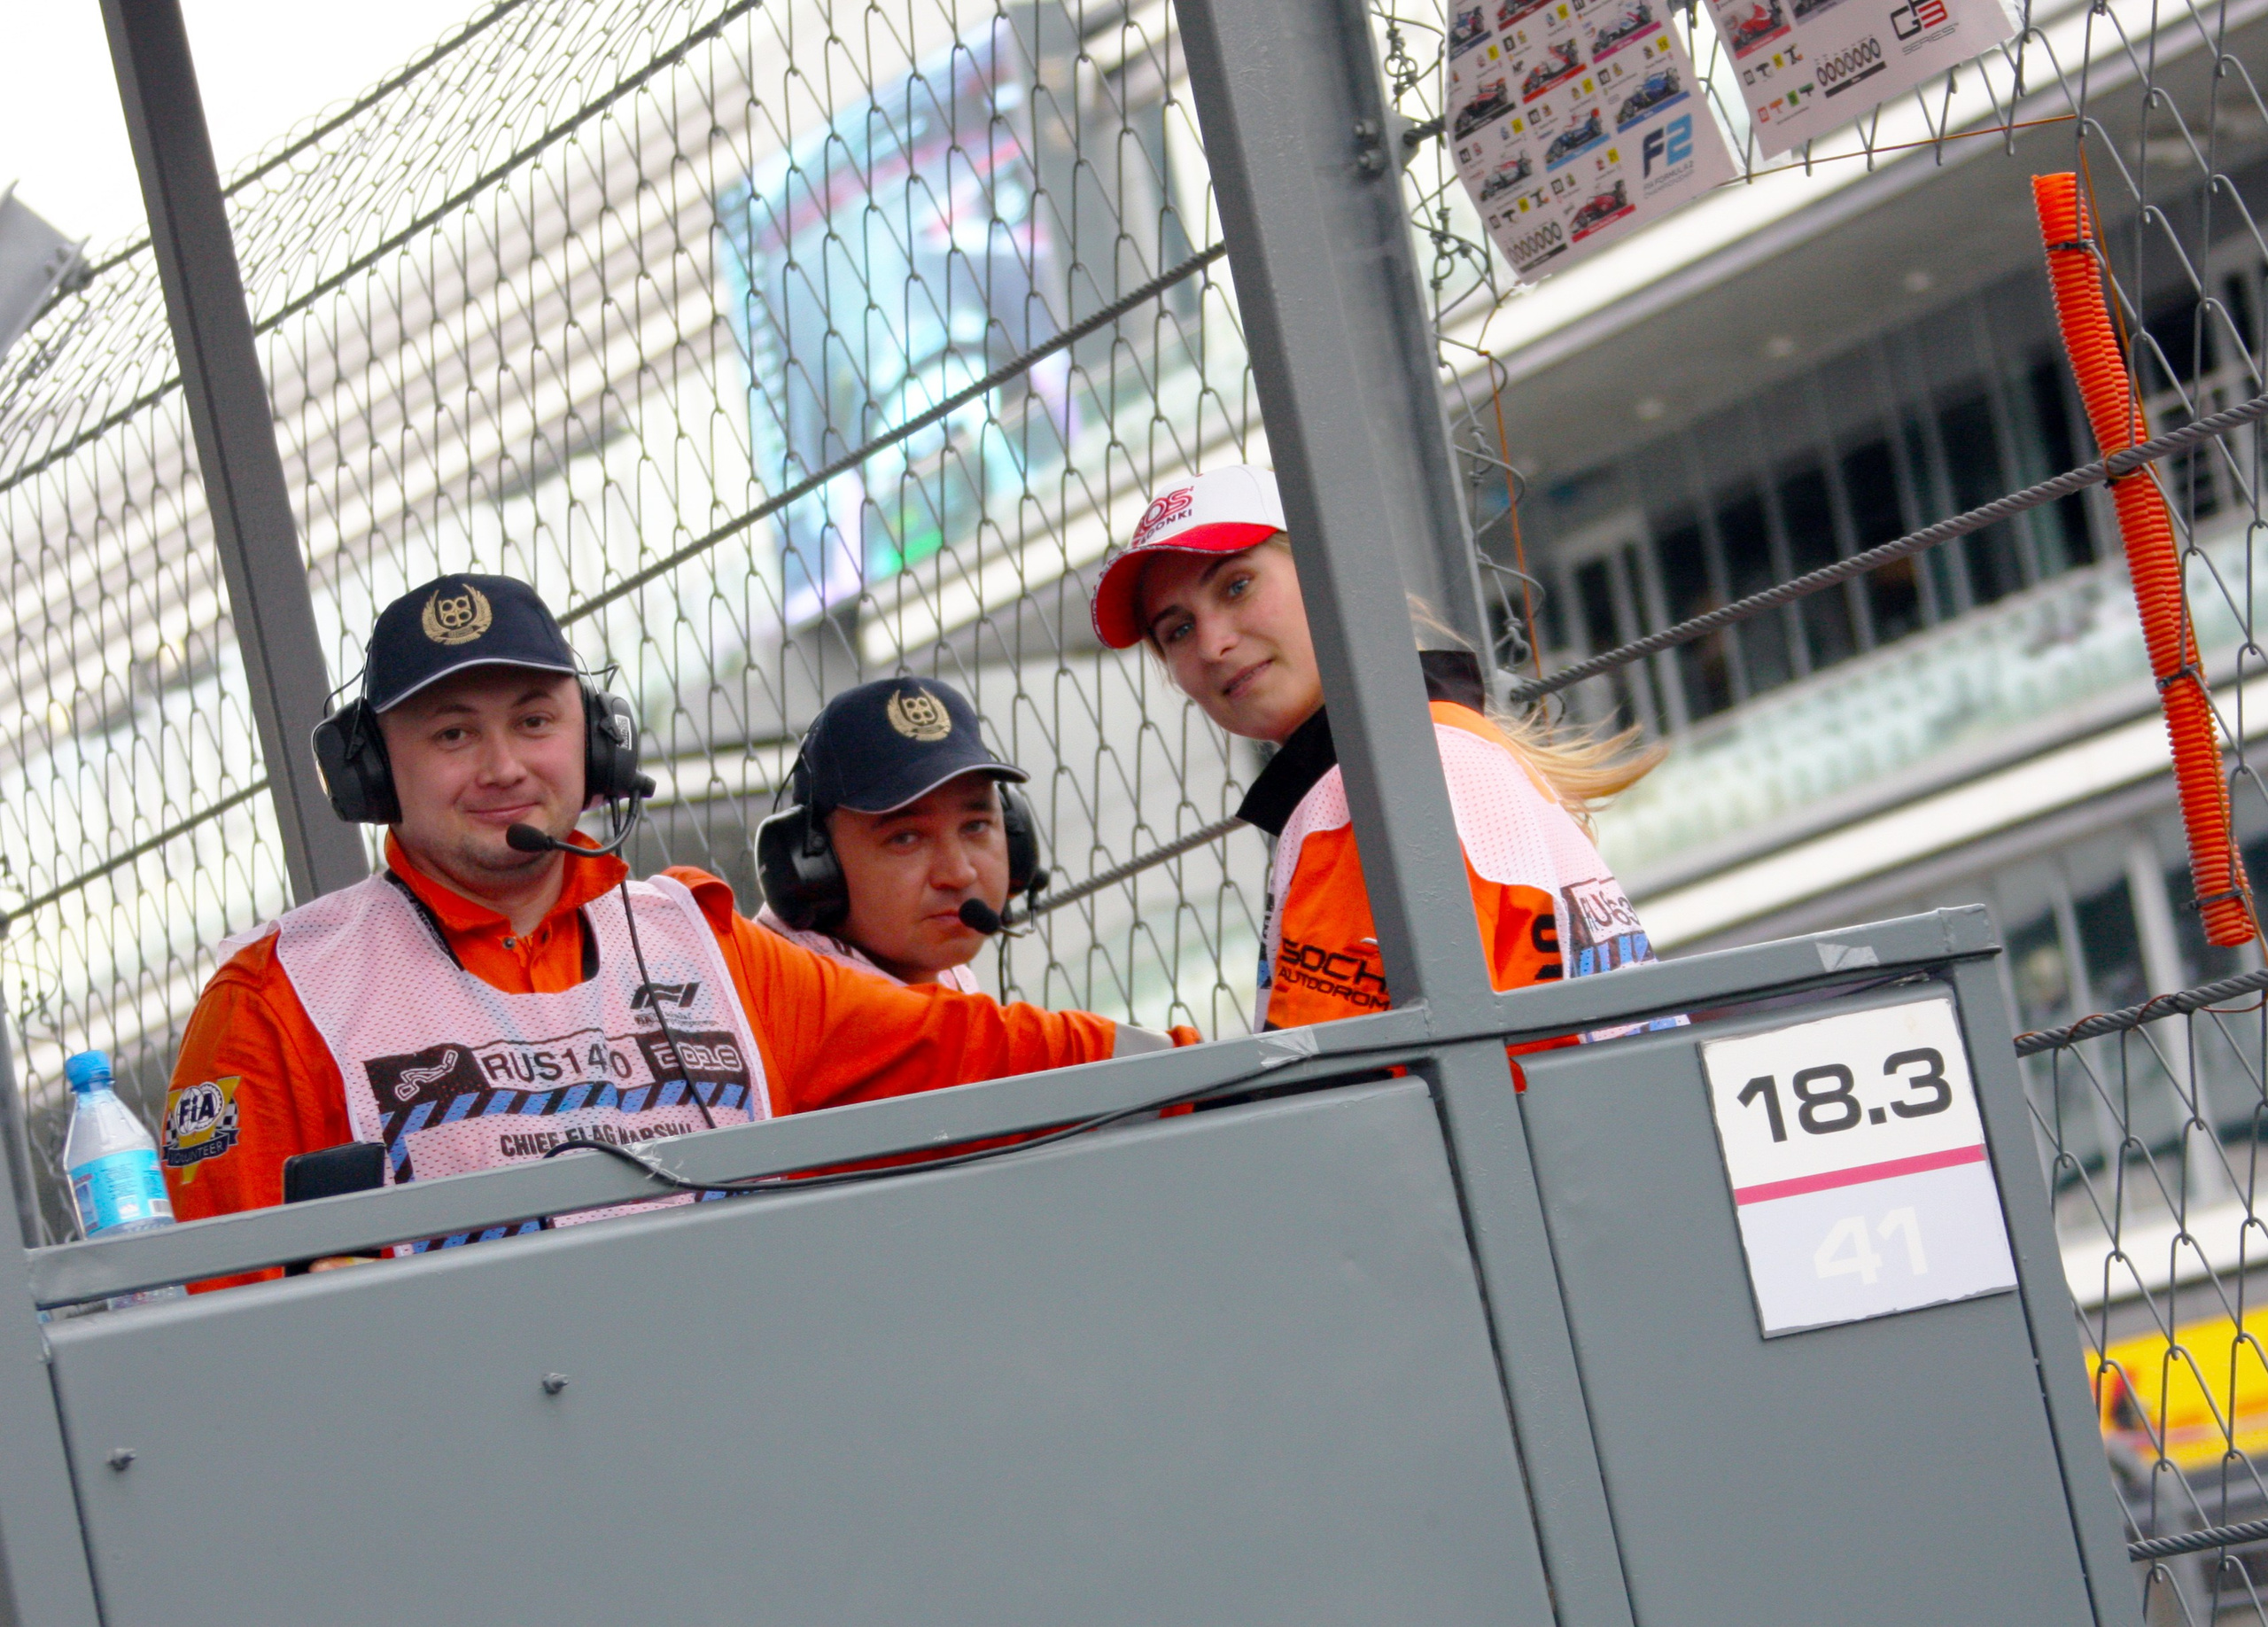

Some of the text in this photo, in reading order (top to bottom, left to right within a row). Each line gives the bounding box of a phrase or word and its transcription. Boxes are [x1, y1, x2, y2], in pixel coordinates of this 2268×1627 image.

[1902, 25, 1957, 56] SERIES
[1643, 113, 1692, 179] F2
[1278, 966, 1391, 1011] AUTODROM
[1281, 938, 1386, 993] SOCH
[481, 1043, 633, 1083] RUS140
[1736, 1047, 1953, 1143] 18.3
[500, 1132, 559, 1157] CHIEF
[564, 1124, 617, 1146] FLAG
[1814, 1205, 1928, 1286] 41
